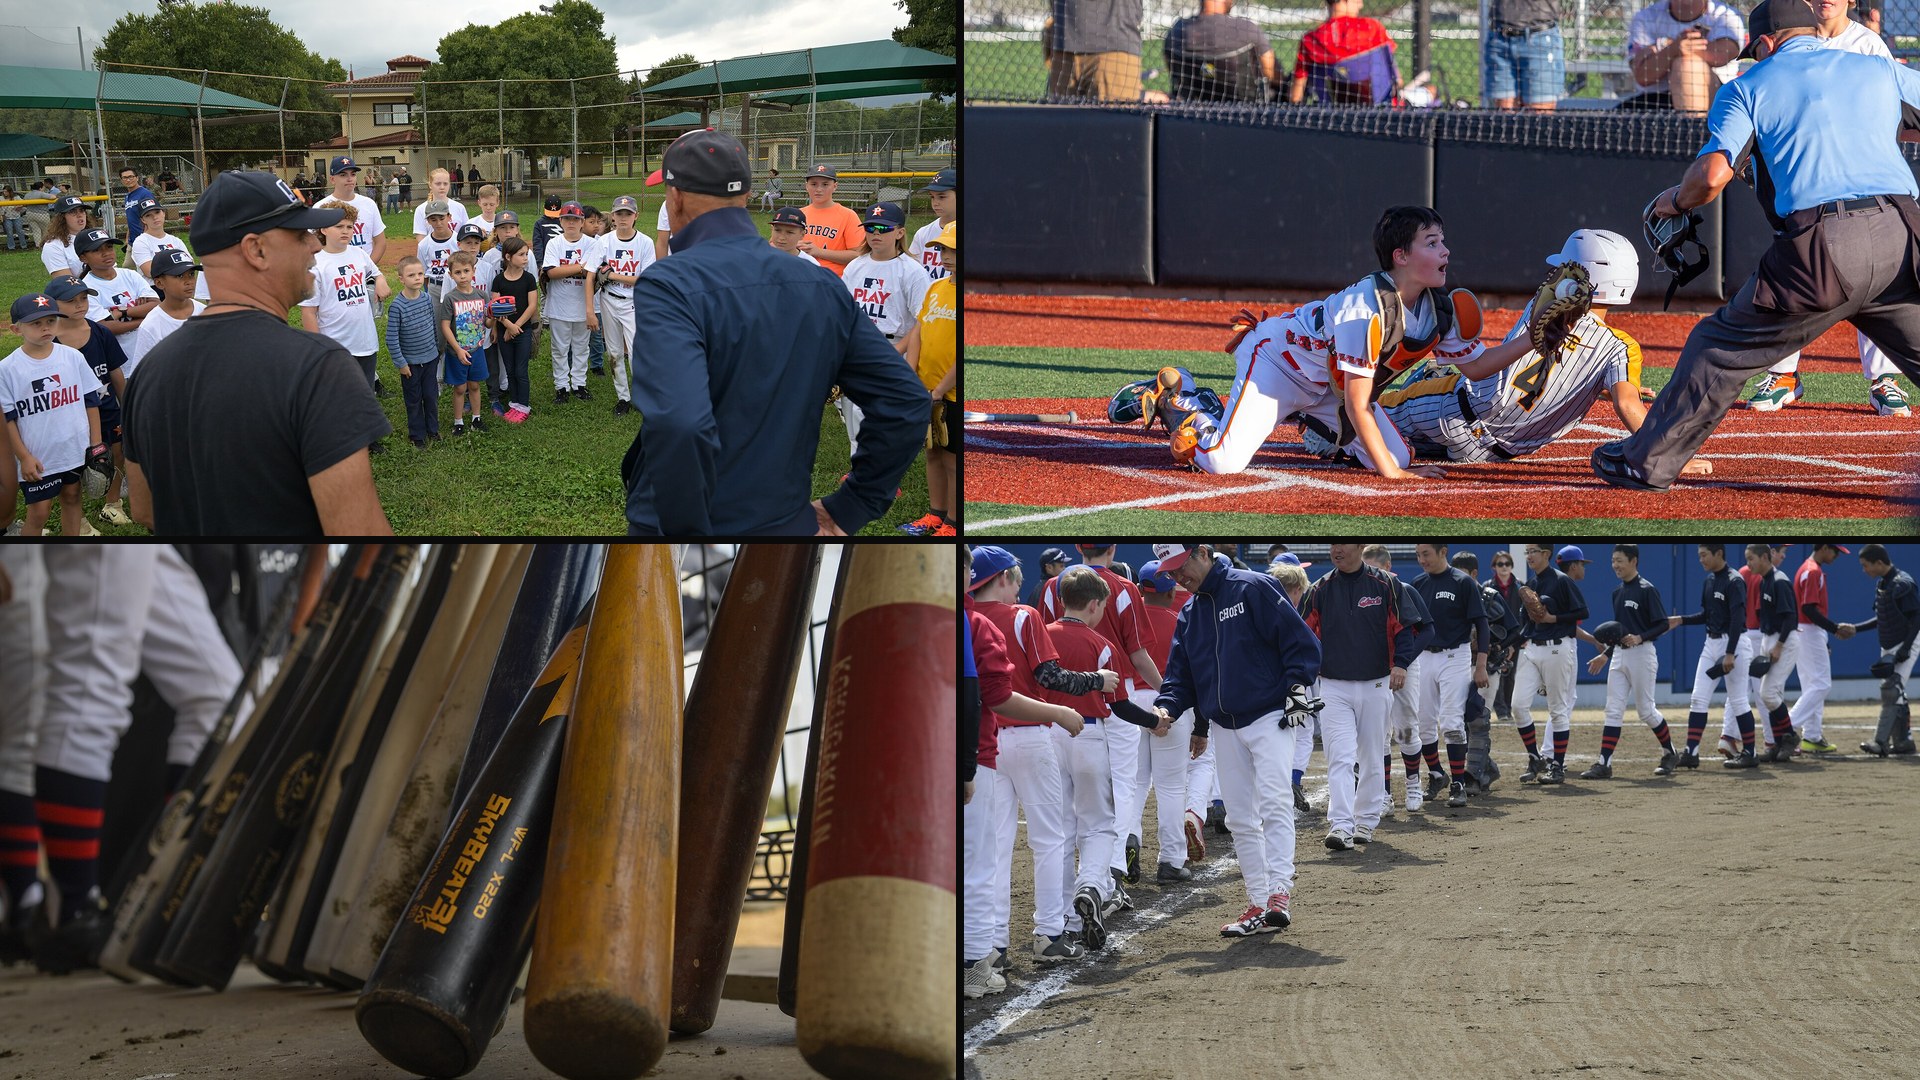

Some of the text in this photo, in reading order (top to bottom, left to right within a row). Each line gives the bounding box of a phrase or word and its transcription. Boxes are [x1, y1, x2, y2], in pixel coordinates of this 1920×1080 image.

[608, 259, 640, 273] PLAY
[334, 271, 363, 291] PLAY
[337, 284, 366, 302] BALL
[853, 288, 892, 305] PLAY
[1620, 288, 1627, 298] 4
[1512, 355, 1557, 413] 4
[28, 478, 63, 493] GIVOVA
[1435, 591, 1456, 601] CHOFU
[1218, 601, 1245, 622] CHOFU
[472, 826, 529, 920] WF-L X220
